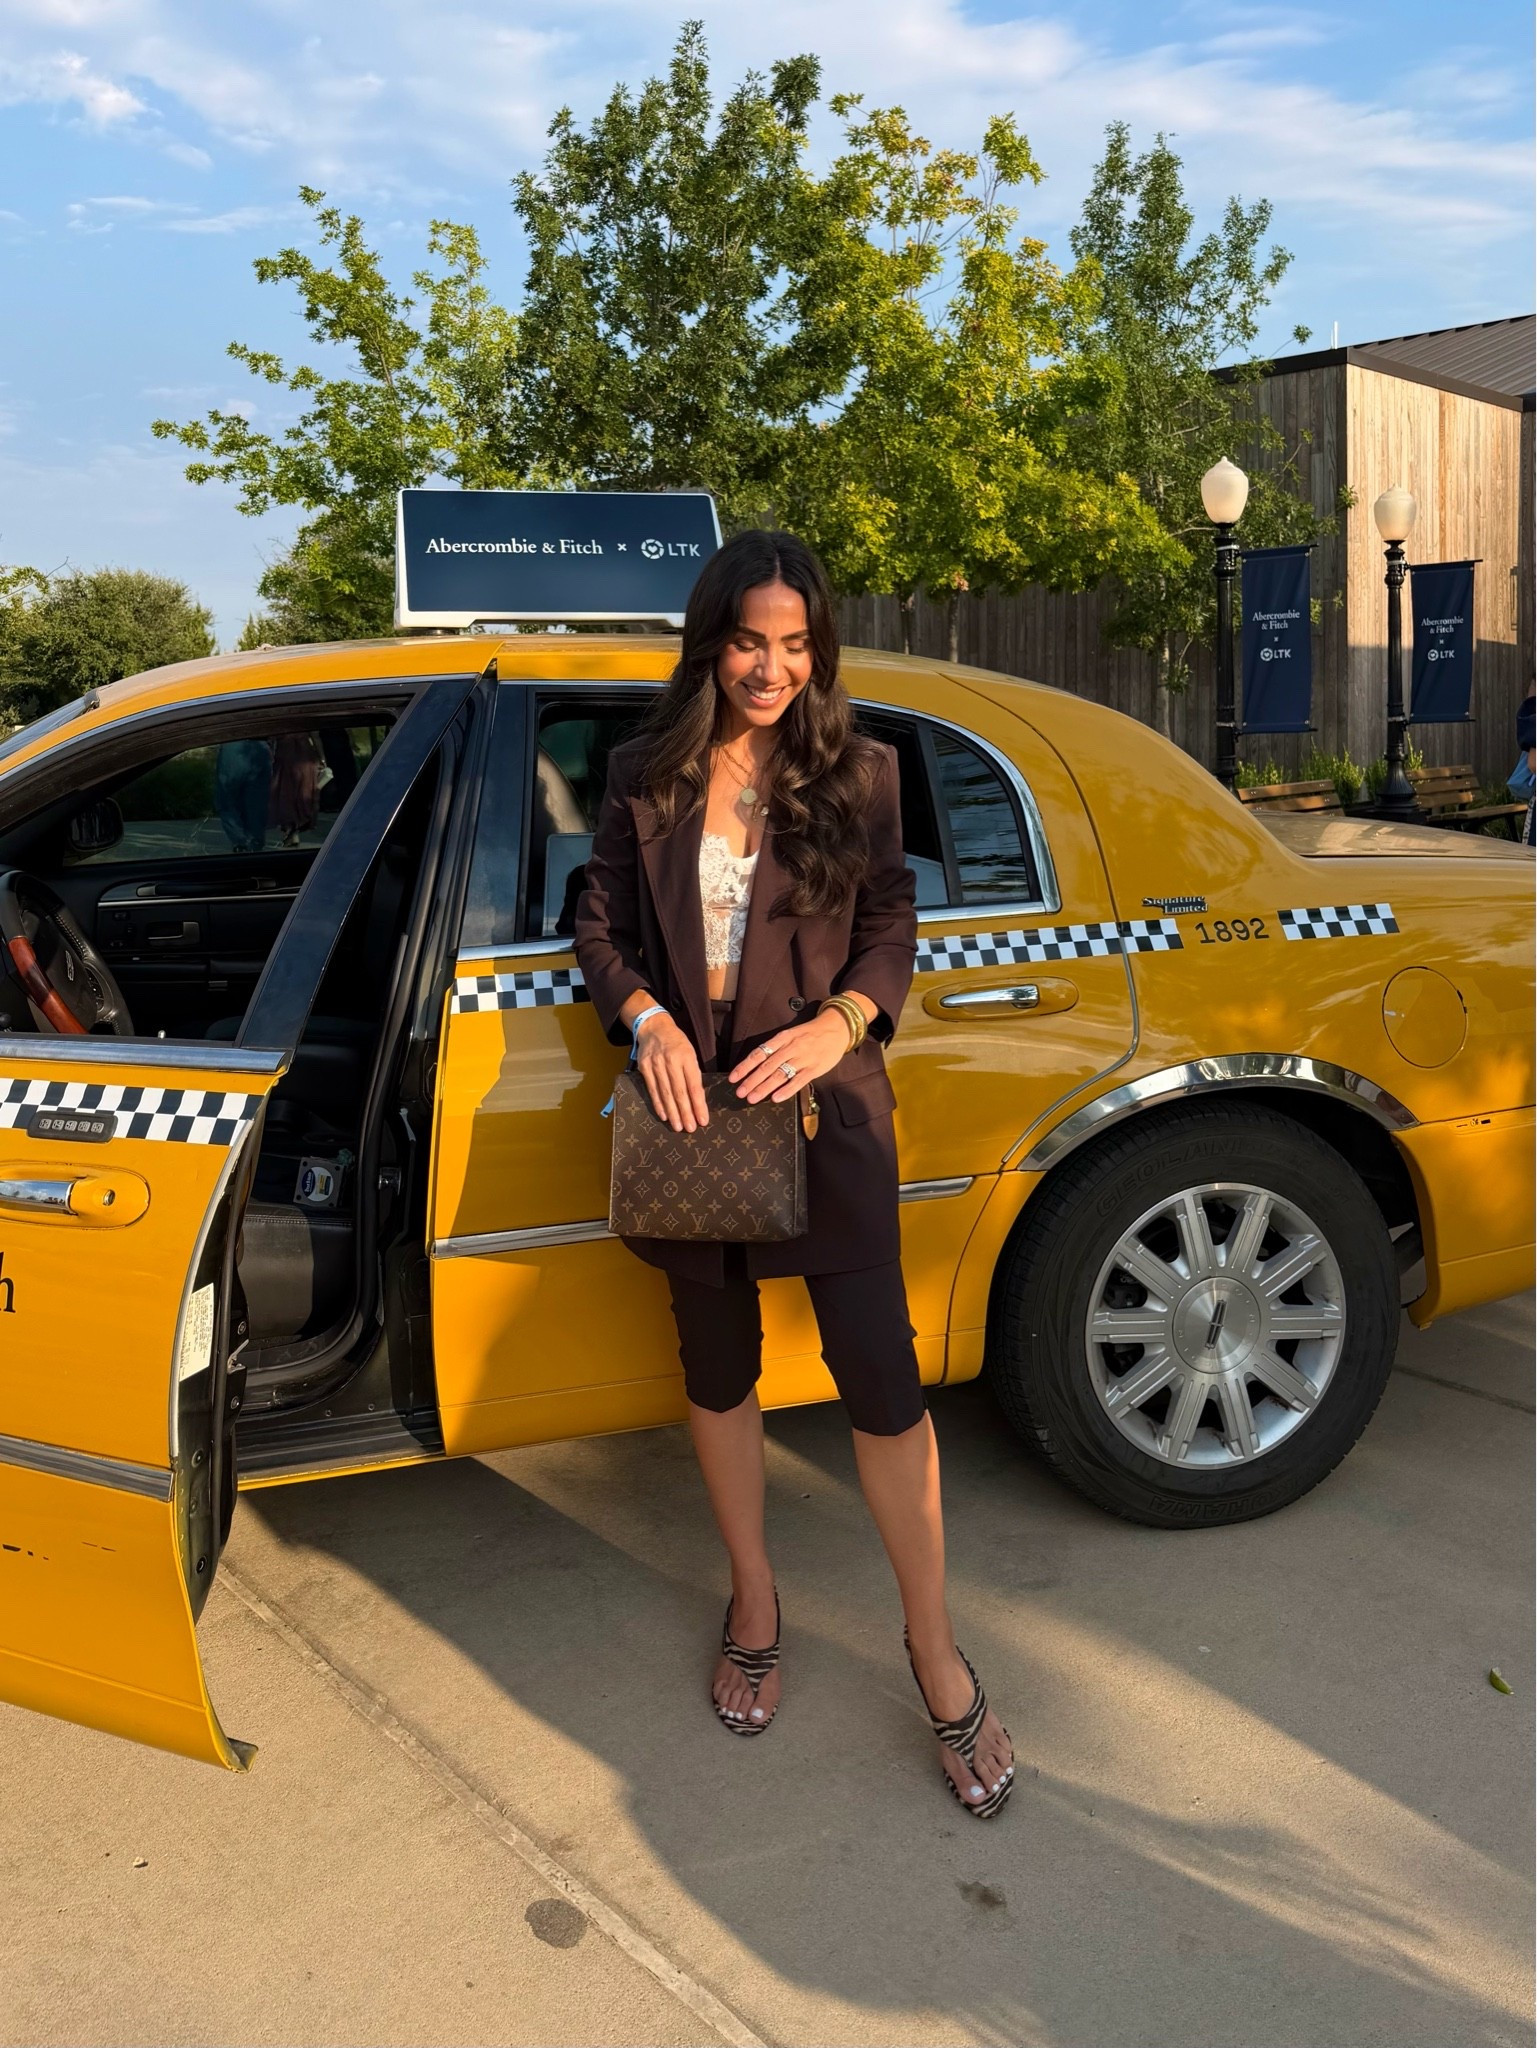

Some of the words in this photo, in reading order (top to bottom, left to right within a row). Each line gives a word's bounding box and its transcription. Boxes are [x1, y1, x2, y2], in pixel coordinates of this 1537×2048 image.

[425, 538, 537, 555] Abercrombie
[542, 542, 556, 555] &
[560, 539, 604, 555] Fitch
[668, 542, 701, 558] LTK
[1252, 609, 1300, 621] Abercrombie
[1269, 620, 1289, 630] Fitch
[1421, 616, 1464, 626] Abercrombie
[1436, 624, 1455, 634] Fitch
[1274, 649, 1292, 659] LTK
[1440, 650, 1455, 659] LTK
[1141, 896, 1205, 906] Signature
[1164, 903, 1208, 914] Limited
[1194, 917, 1270, 944] 1892
